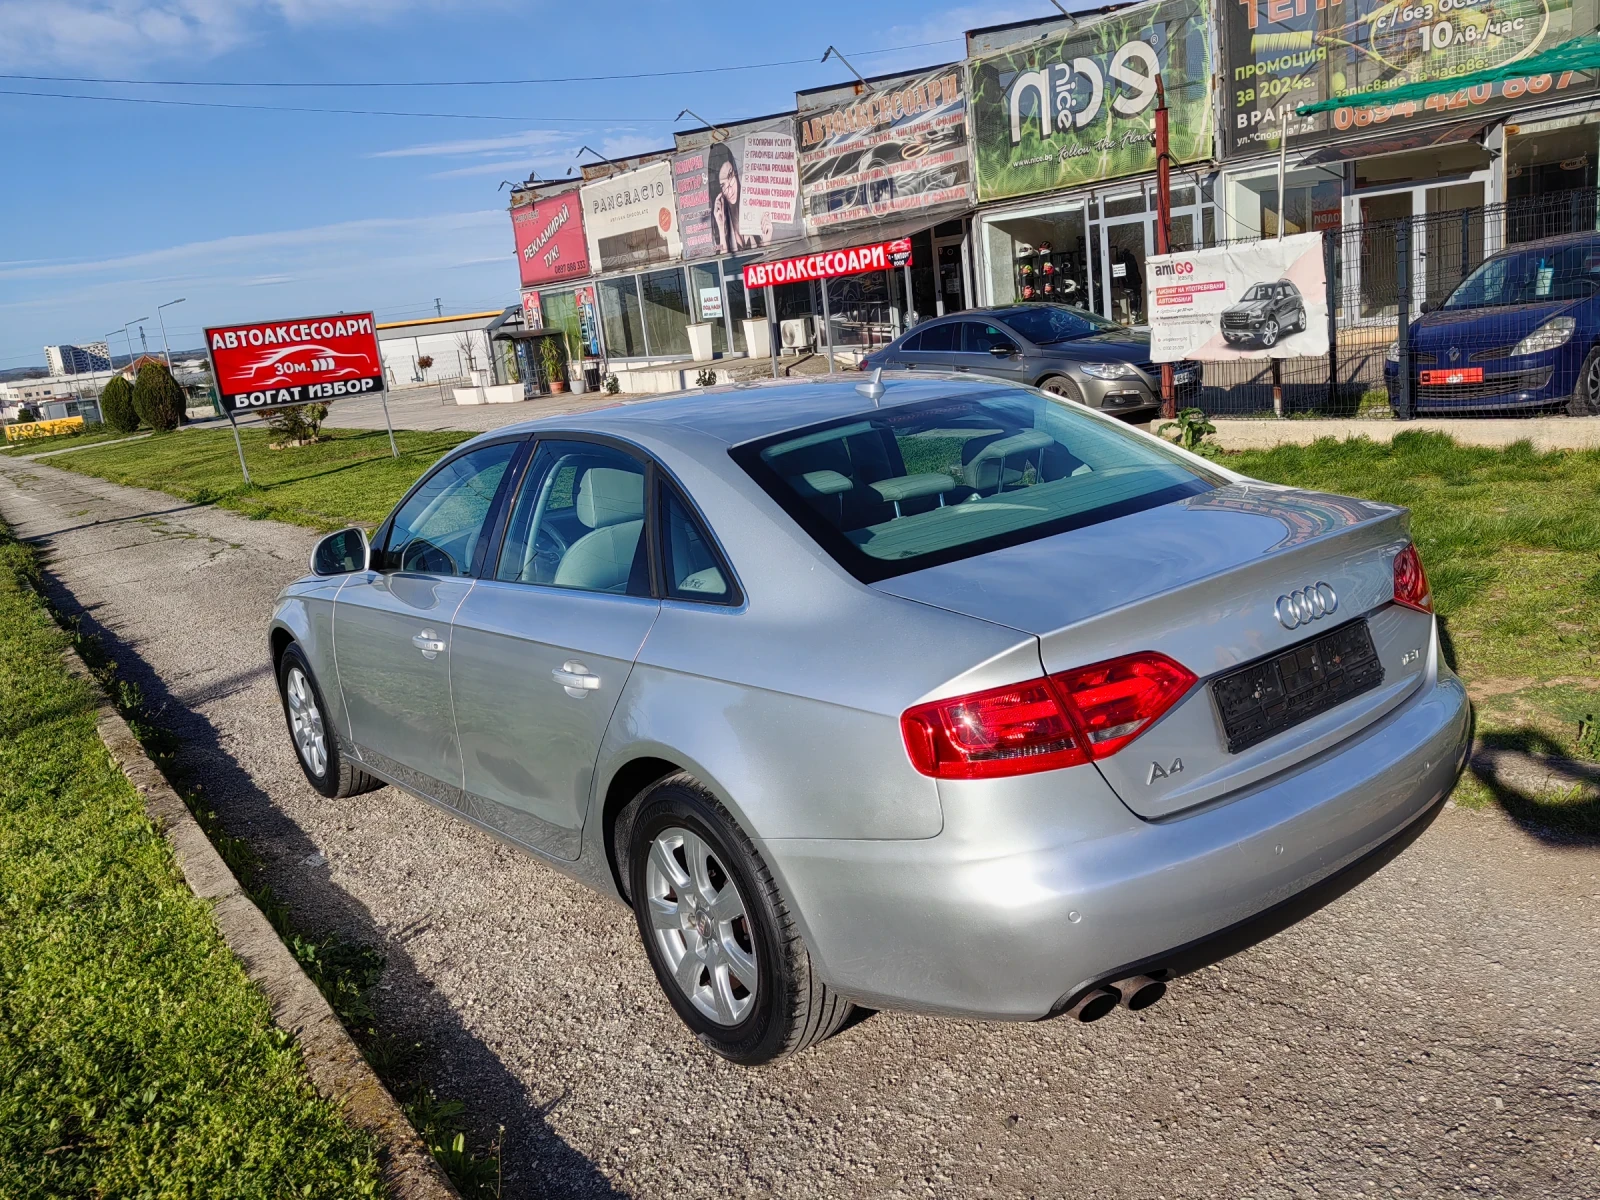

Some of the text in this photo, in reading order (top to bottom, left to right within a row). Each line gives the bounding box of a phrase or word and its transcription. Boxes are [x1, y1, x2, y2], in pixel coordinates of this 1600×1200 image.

[1402, 5, 1433, 21] без
[1235, 46, 1327, 81] ПРОМОЦИЯ
[1259, 73, 1315, 98] 2024г.
[1334, 75, 1406, 98] записване
[1411, 71, 1428, 83] на
[801, 74, 958, 147] АВТОАКСЕСОАРИ
[1333, 101, 1417, 131] 0894
[1013, 153, 1053, 168] www.nice.bg
[593, 182, 664, 214] PANCRACIO
[523, 203, 570, 262] РЕКЛАМИРАЙ
[543, 245, 560, 268] ТУК!
[747, 245, 885, 286] АВТОАКСЕСОАРИ
[1158, 295, 1192, 305] АВТОМОБИЛИ
[212, 318, 372, 350] АВТОАКСЕСОАРИ
[234, 378, 374, 408] БОГАТ ИЗБОР
